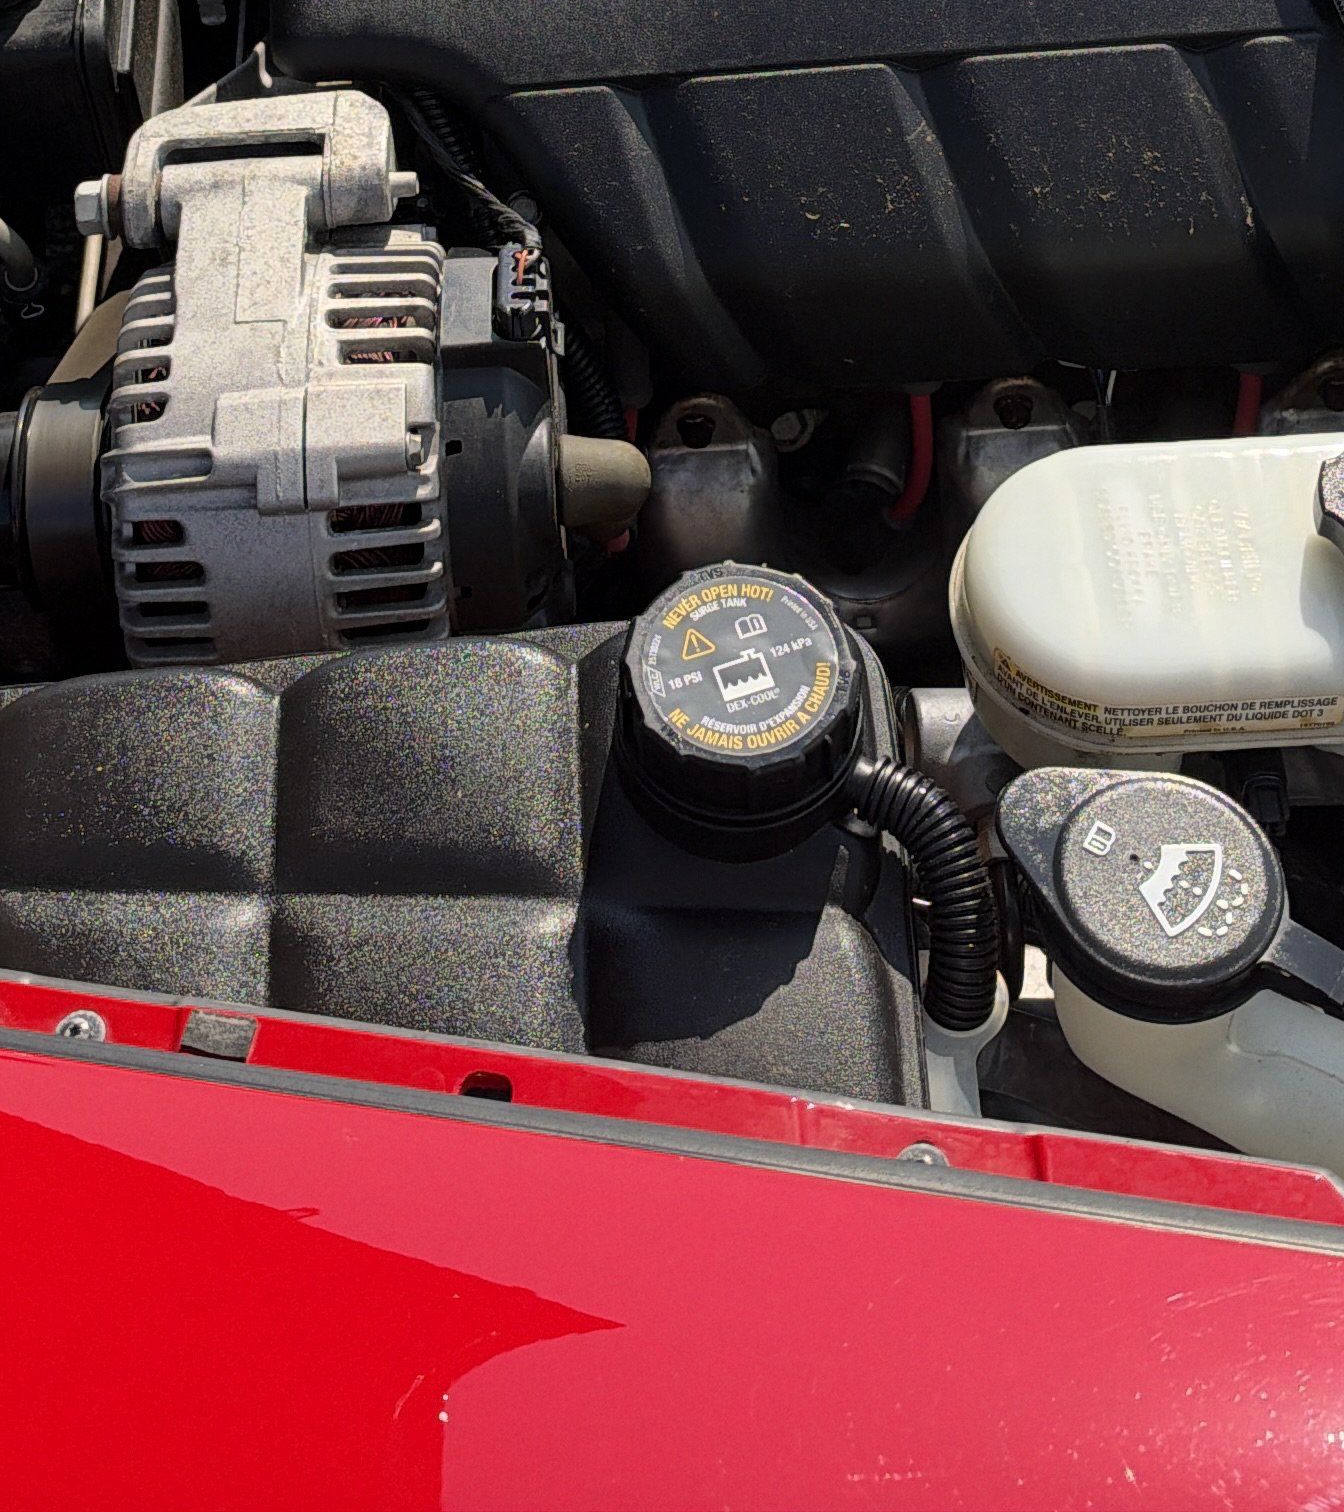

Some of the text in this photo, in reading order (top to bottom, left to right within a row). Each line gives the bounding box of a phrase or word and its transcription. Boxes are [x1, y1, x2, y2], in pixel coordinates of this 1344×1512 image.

[662, 583, 774, 630] NEVER OPEN HOT!
[689, 597, 747, 621] SURGE TANK
[770, 636, 812, 658] 124 kPa
[667, 670, 703, 690] 18 PSI
[998, 665, 1024, 689] AVANT
[1026, 687, 1039, 702] DE
[1105, 717, 1154, 728] UTILISER
[1157, 713, 1224, 725] SEULEMENT
[1226, 713, 1241, 722] DU
[1245, 710, 1289, 721] LIQUIDE
[1292, 709, 1313, 718] DOT
[1316, 709, 1324, 717] 3
[1016, 670, 1339, 716] AVERTISSEMENT NETTOYER LE BOUCHON DE REMPLISSAGE
[668, 707, 690, 728] NE
[686, 723, 742, 749] JAMAIS
[747, 717, 800, 749] OUVRIR
[808, 661, 831, 712] CHAUD!
[700, 685, 811, 734] RÉSERVOIR D'EXPANSION
[1017, 692, 1080, 730] CONTENANT
